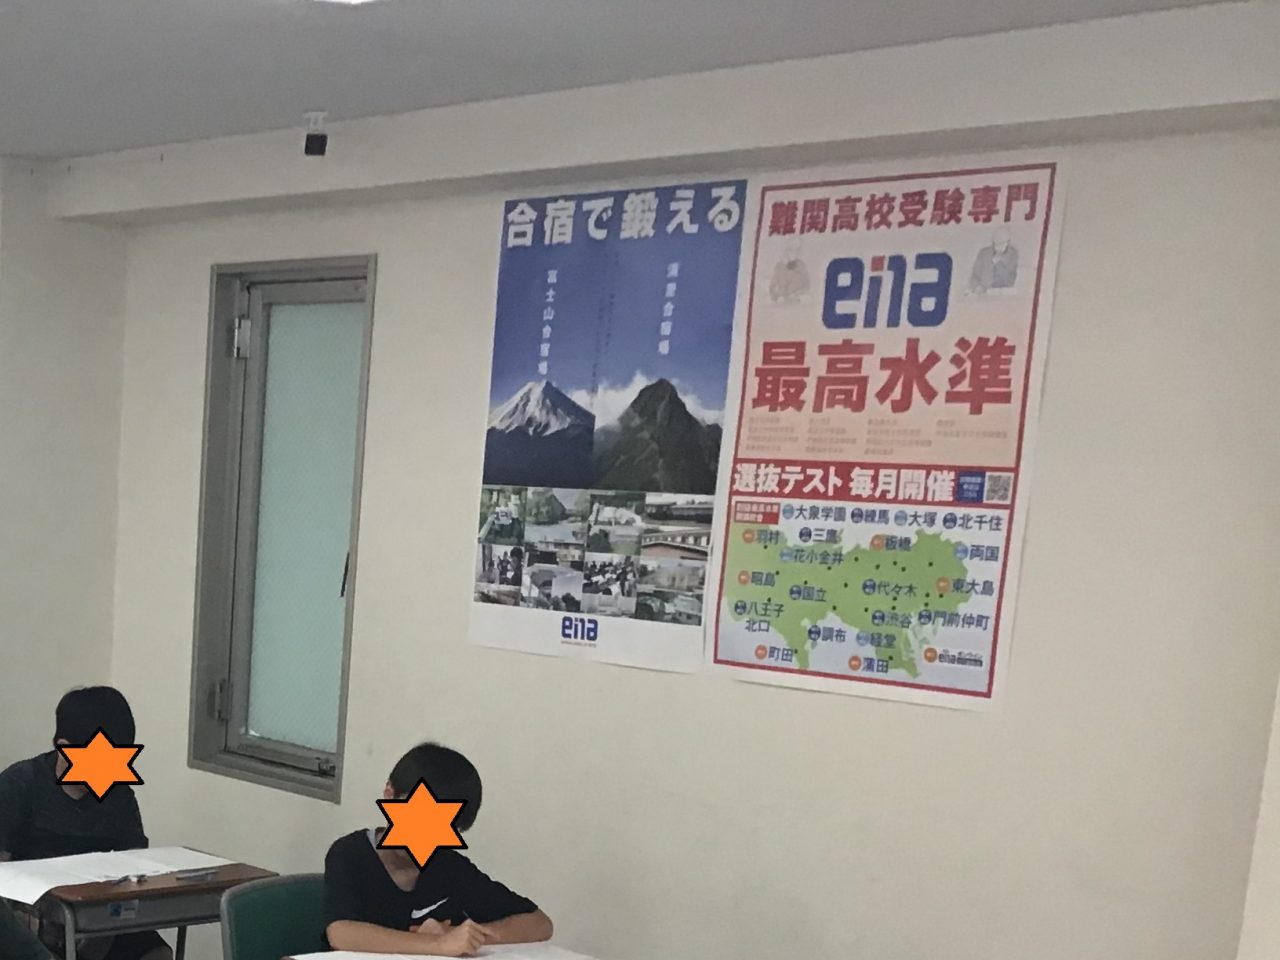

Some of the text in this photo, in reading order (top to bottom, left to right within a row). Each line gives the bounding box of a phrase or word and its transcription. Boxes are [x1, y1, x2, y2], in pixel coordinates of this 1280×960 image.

[507, 186, 741, 248] 合宿で鍛える
[769, 183, 1039, 237] 難関高校受験専門
[822, 252, 954, 329] ena
[752, 336, 1016, 415] 最高水準
[733, 463, 843, 496] 選抜テスト
[849, 466, 956, 502] 毎月開催
[795, 505, 846, 522] 大泉学園
[908, 511, 937, 528] 大塚
[958, 513, 1003, 531] 北千住
[885, 535, 912, 551] 板橋
[793, 549, 844, 565] 花小金井
[969, 546, 1000, 562] 両国
[802, 585, 827, 602] 国立
[877, 578, 917, 597] 代々木
[951, 578, 994, 597] 東大島
[747, 600, 784, 618] 八王子
[561, 616, 598, 641] ena
[745, 618, 770, 633] 北口
[932, 610, 990, 631] 門前仲町
[822, 626, 847, 643] 調布
[768, 646, 793, 663] 町田
